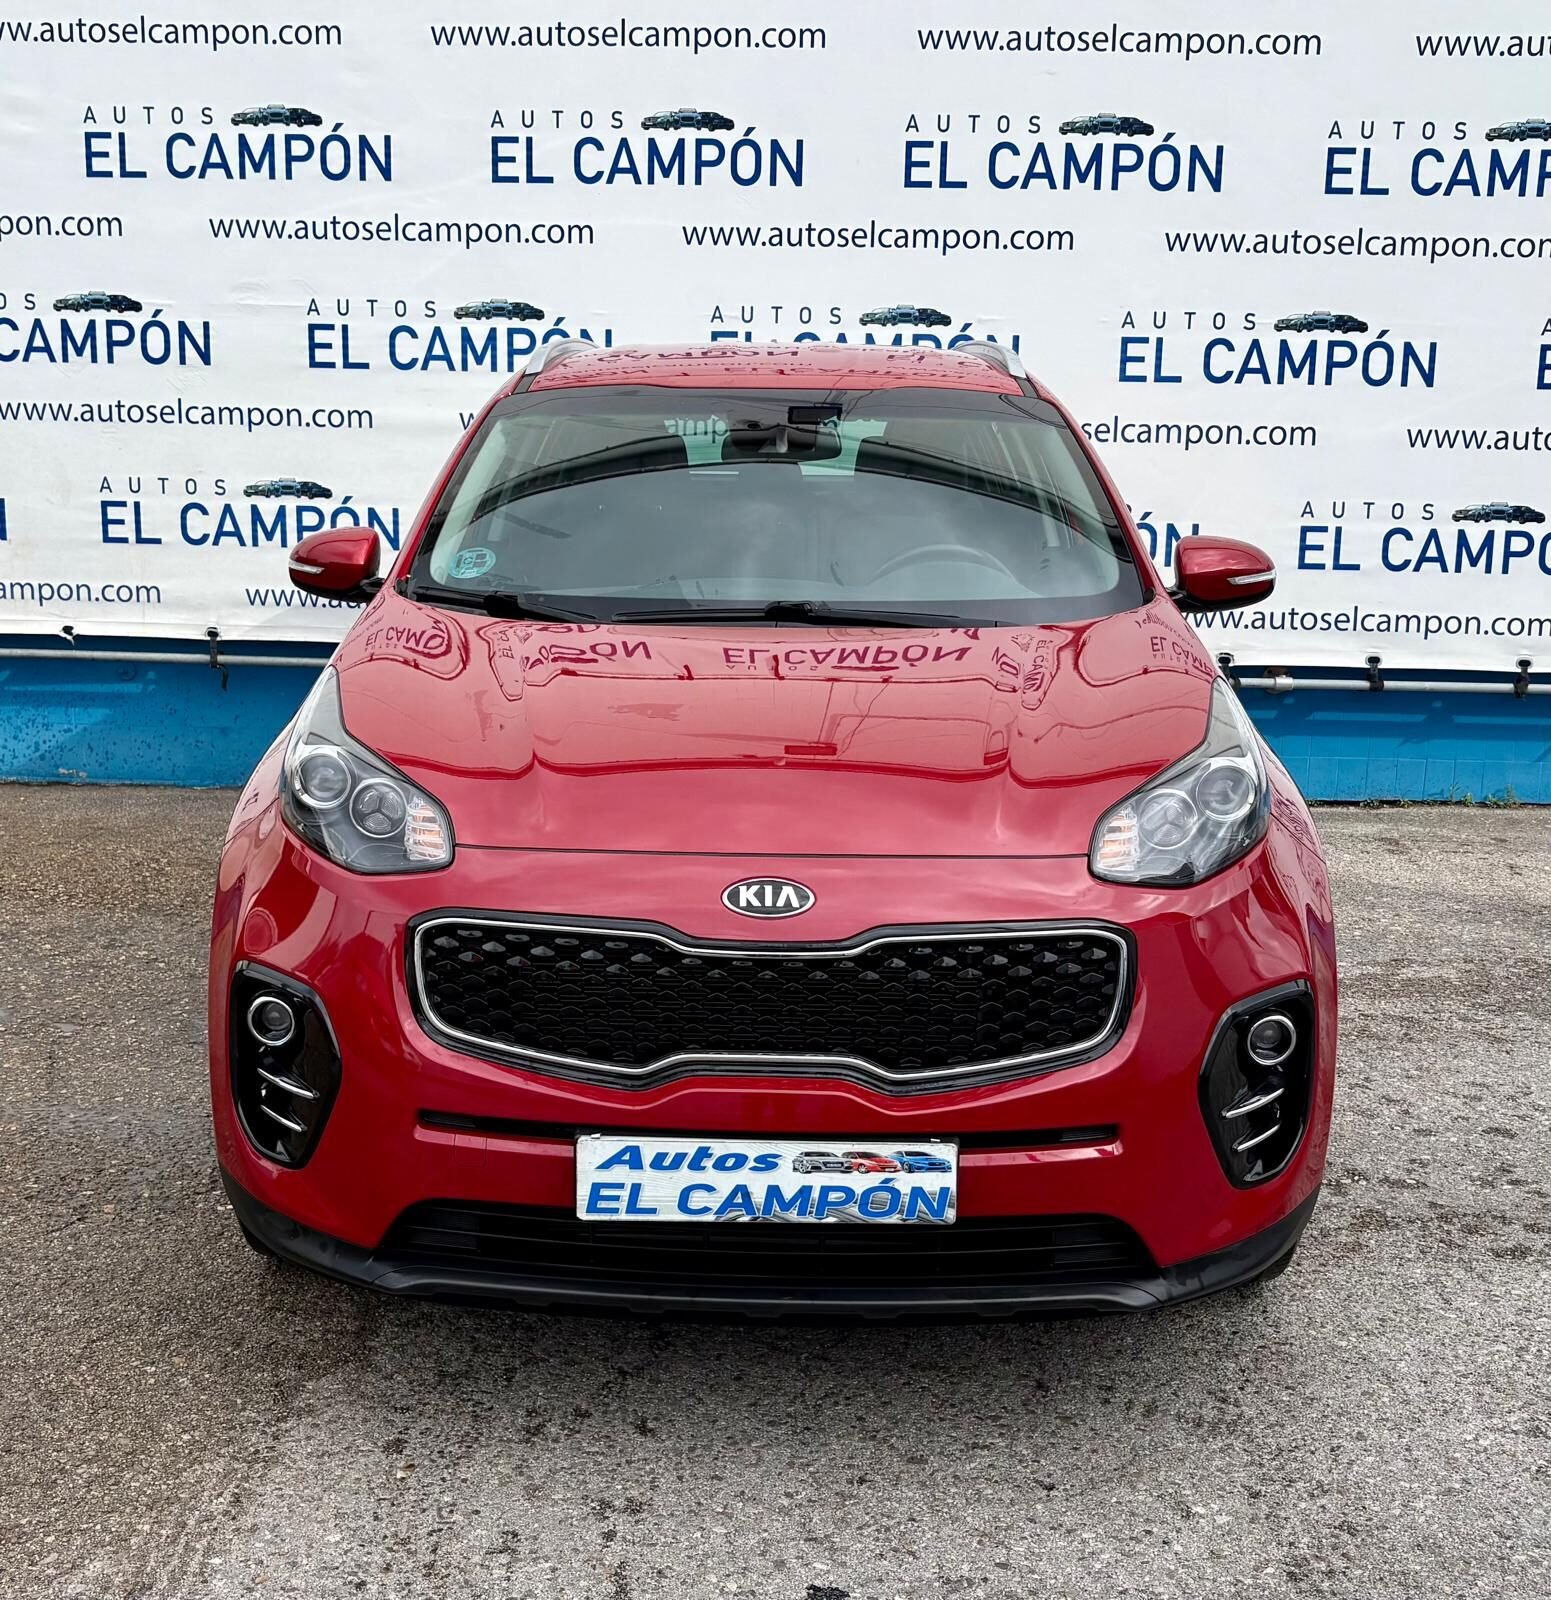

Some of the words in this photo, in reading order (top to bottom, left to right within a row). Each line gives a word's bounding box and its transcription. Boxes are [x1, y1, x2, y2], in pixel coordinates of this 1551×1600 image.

[0, 15, 342, 52] w.autoselcampon.com
[430, 17, 826, 55] www.autoselcampon.com
[917, 23, 1322, 61] www.autoselcampon.com
[83, 105, 213, 125] AUTOS
[490, 109, 623, 130] AUTOS
[905, 113, 1041, 134] AUTOS
[1327, 120, 1467, 141] AUTOS
[84, 131, 148, 179] EL
[165, 123, 392, 182] CAMPÓN
[491, 135, 554, 184] EL
[573, 126, 804, 187] CAMPÓN
[903, 140, 968, 189] EL
[988, 132, 1224, 193] CAMPÓN
[1324, 146, 1390, 196] EL
[208, 213, 594, 250] www.autoselcampon.com
[682, 219, 1074, 257] www.autoselcampon.com
[306, 298, 437, 318] AUTOS
[710, 305, 842, 325] AUTOS
[1121, 310, 1256, 331] AUTOS
[307, 323, 370, 370] EL
[1118, 336, 1183, 384] EL
[1203, 329, 1438, 388] CAMPÓN
[0, 397, 373, 433] www.autoselcampon.com
[99, 476, 226, 496] AUTOS
[100, 500, 163, 545] EL
[1300, 500, 1434, 521] AUTOS
[1297, 525, 1361, 571] EL
[738, 884, 800, 908] KIA
[594, 1144, 783, 1173] Autos
[585, 1182, 658, 1216] EL
[676, 1177, 952, 1220] CAMPÓN
